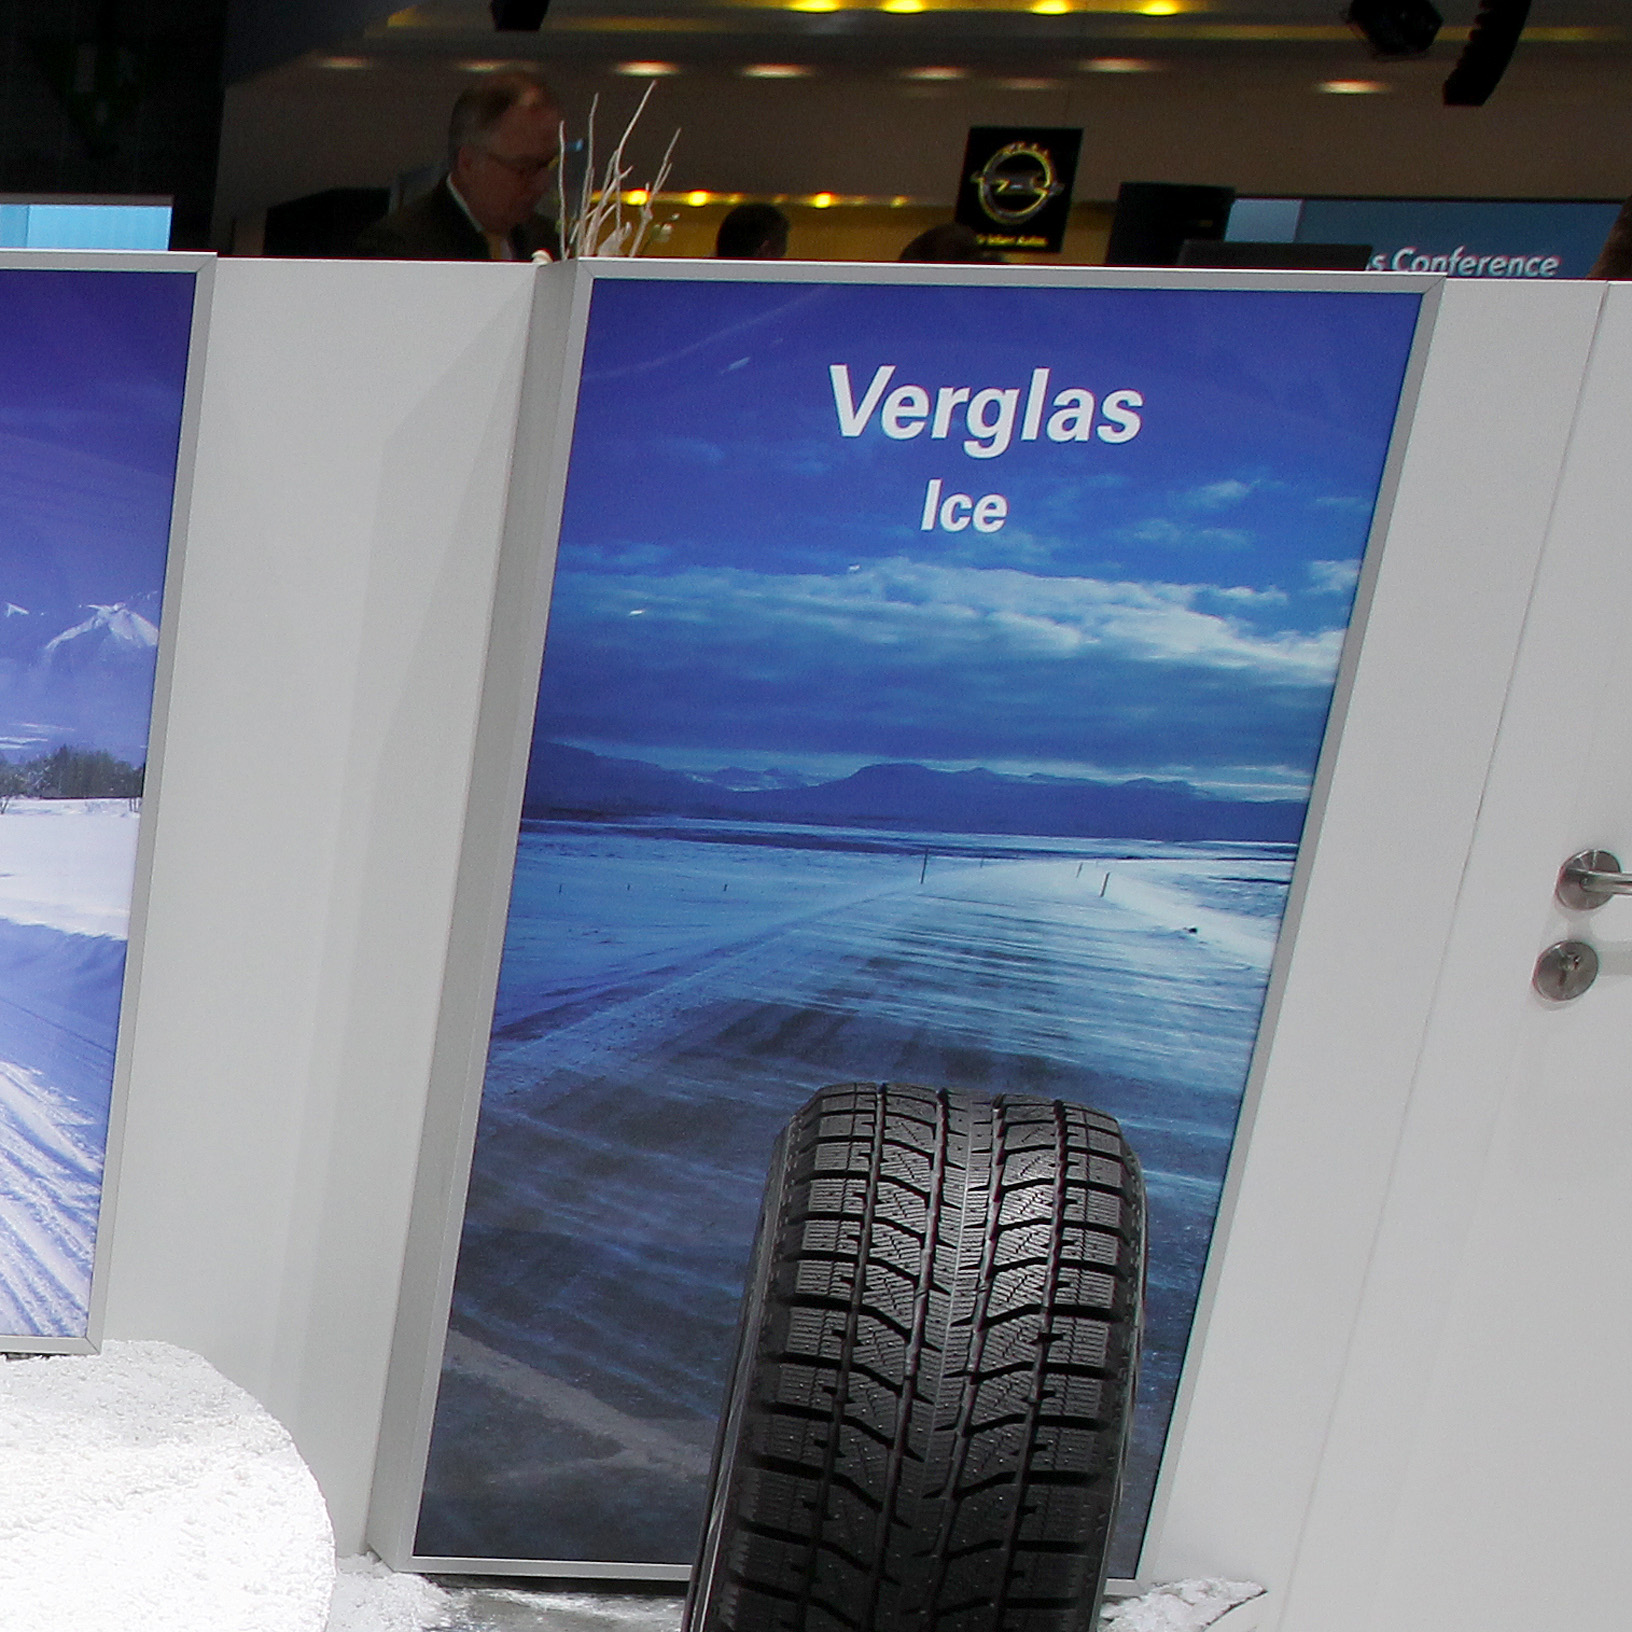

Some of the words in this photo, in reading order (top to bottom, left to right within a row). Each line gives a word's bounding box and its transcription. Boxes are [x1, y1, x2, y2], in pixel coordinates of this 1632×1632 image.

[1392, 245, 1561, 277] Conference
[829, 364, 1145, 459] Verglas
[920, 478, 1009, 533] Ice
